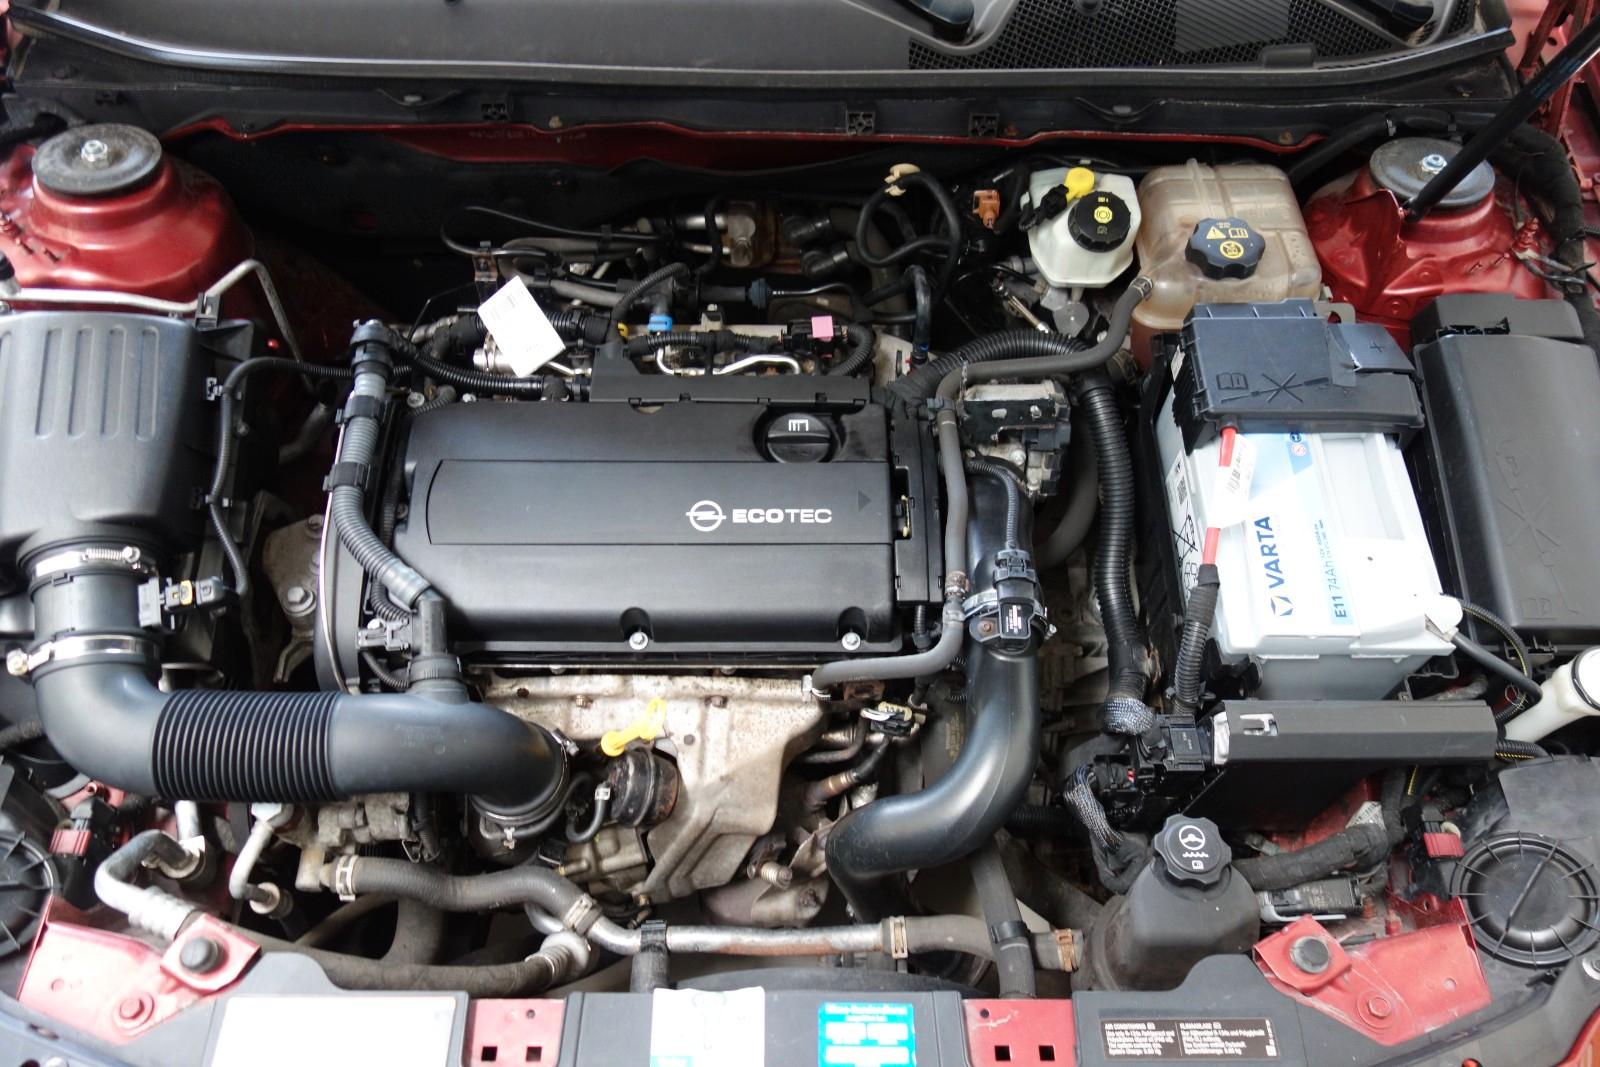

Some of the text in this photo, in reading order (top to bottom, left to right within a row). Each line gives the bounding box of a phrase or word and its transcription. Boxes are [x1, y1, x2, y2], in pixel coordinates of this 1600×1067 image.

[732, 508, 833, 523] ECOTEC
[1254, 516, 1285, 589] VARTA
[1324, 560, 1340, 591] 74Ah
[1331, 595, 1348, 618] E11
